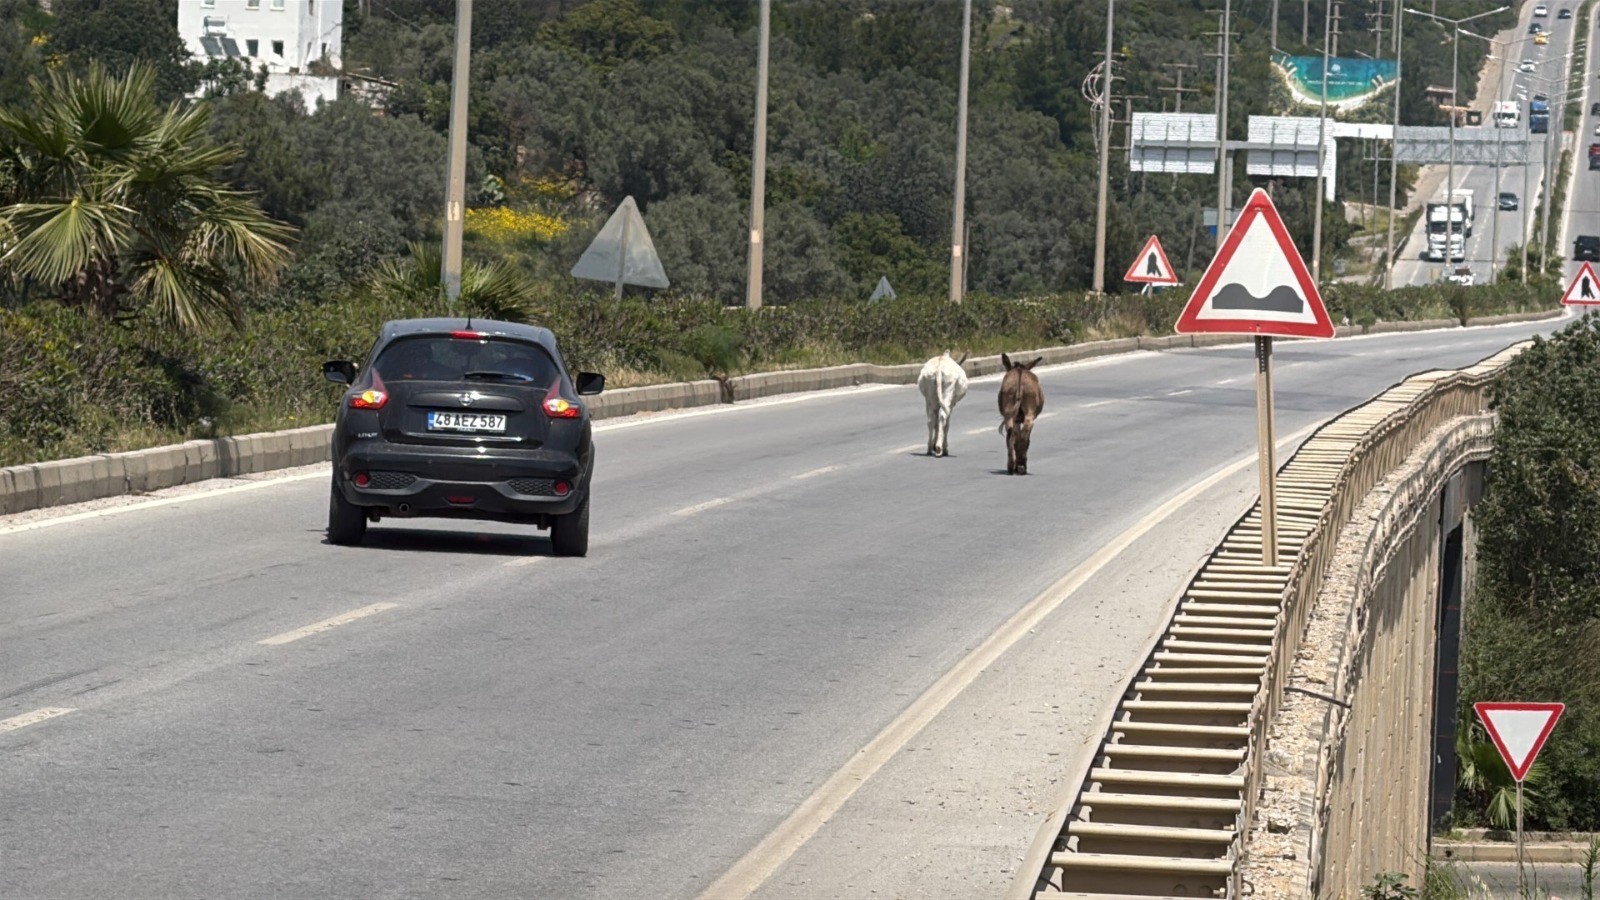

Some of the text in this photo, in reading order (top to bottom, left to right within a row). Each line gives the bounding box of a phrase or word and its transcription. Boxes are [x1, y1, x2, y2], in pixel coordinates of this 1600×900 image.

[435, 413, 504, 429] 48 AEZ 587
